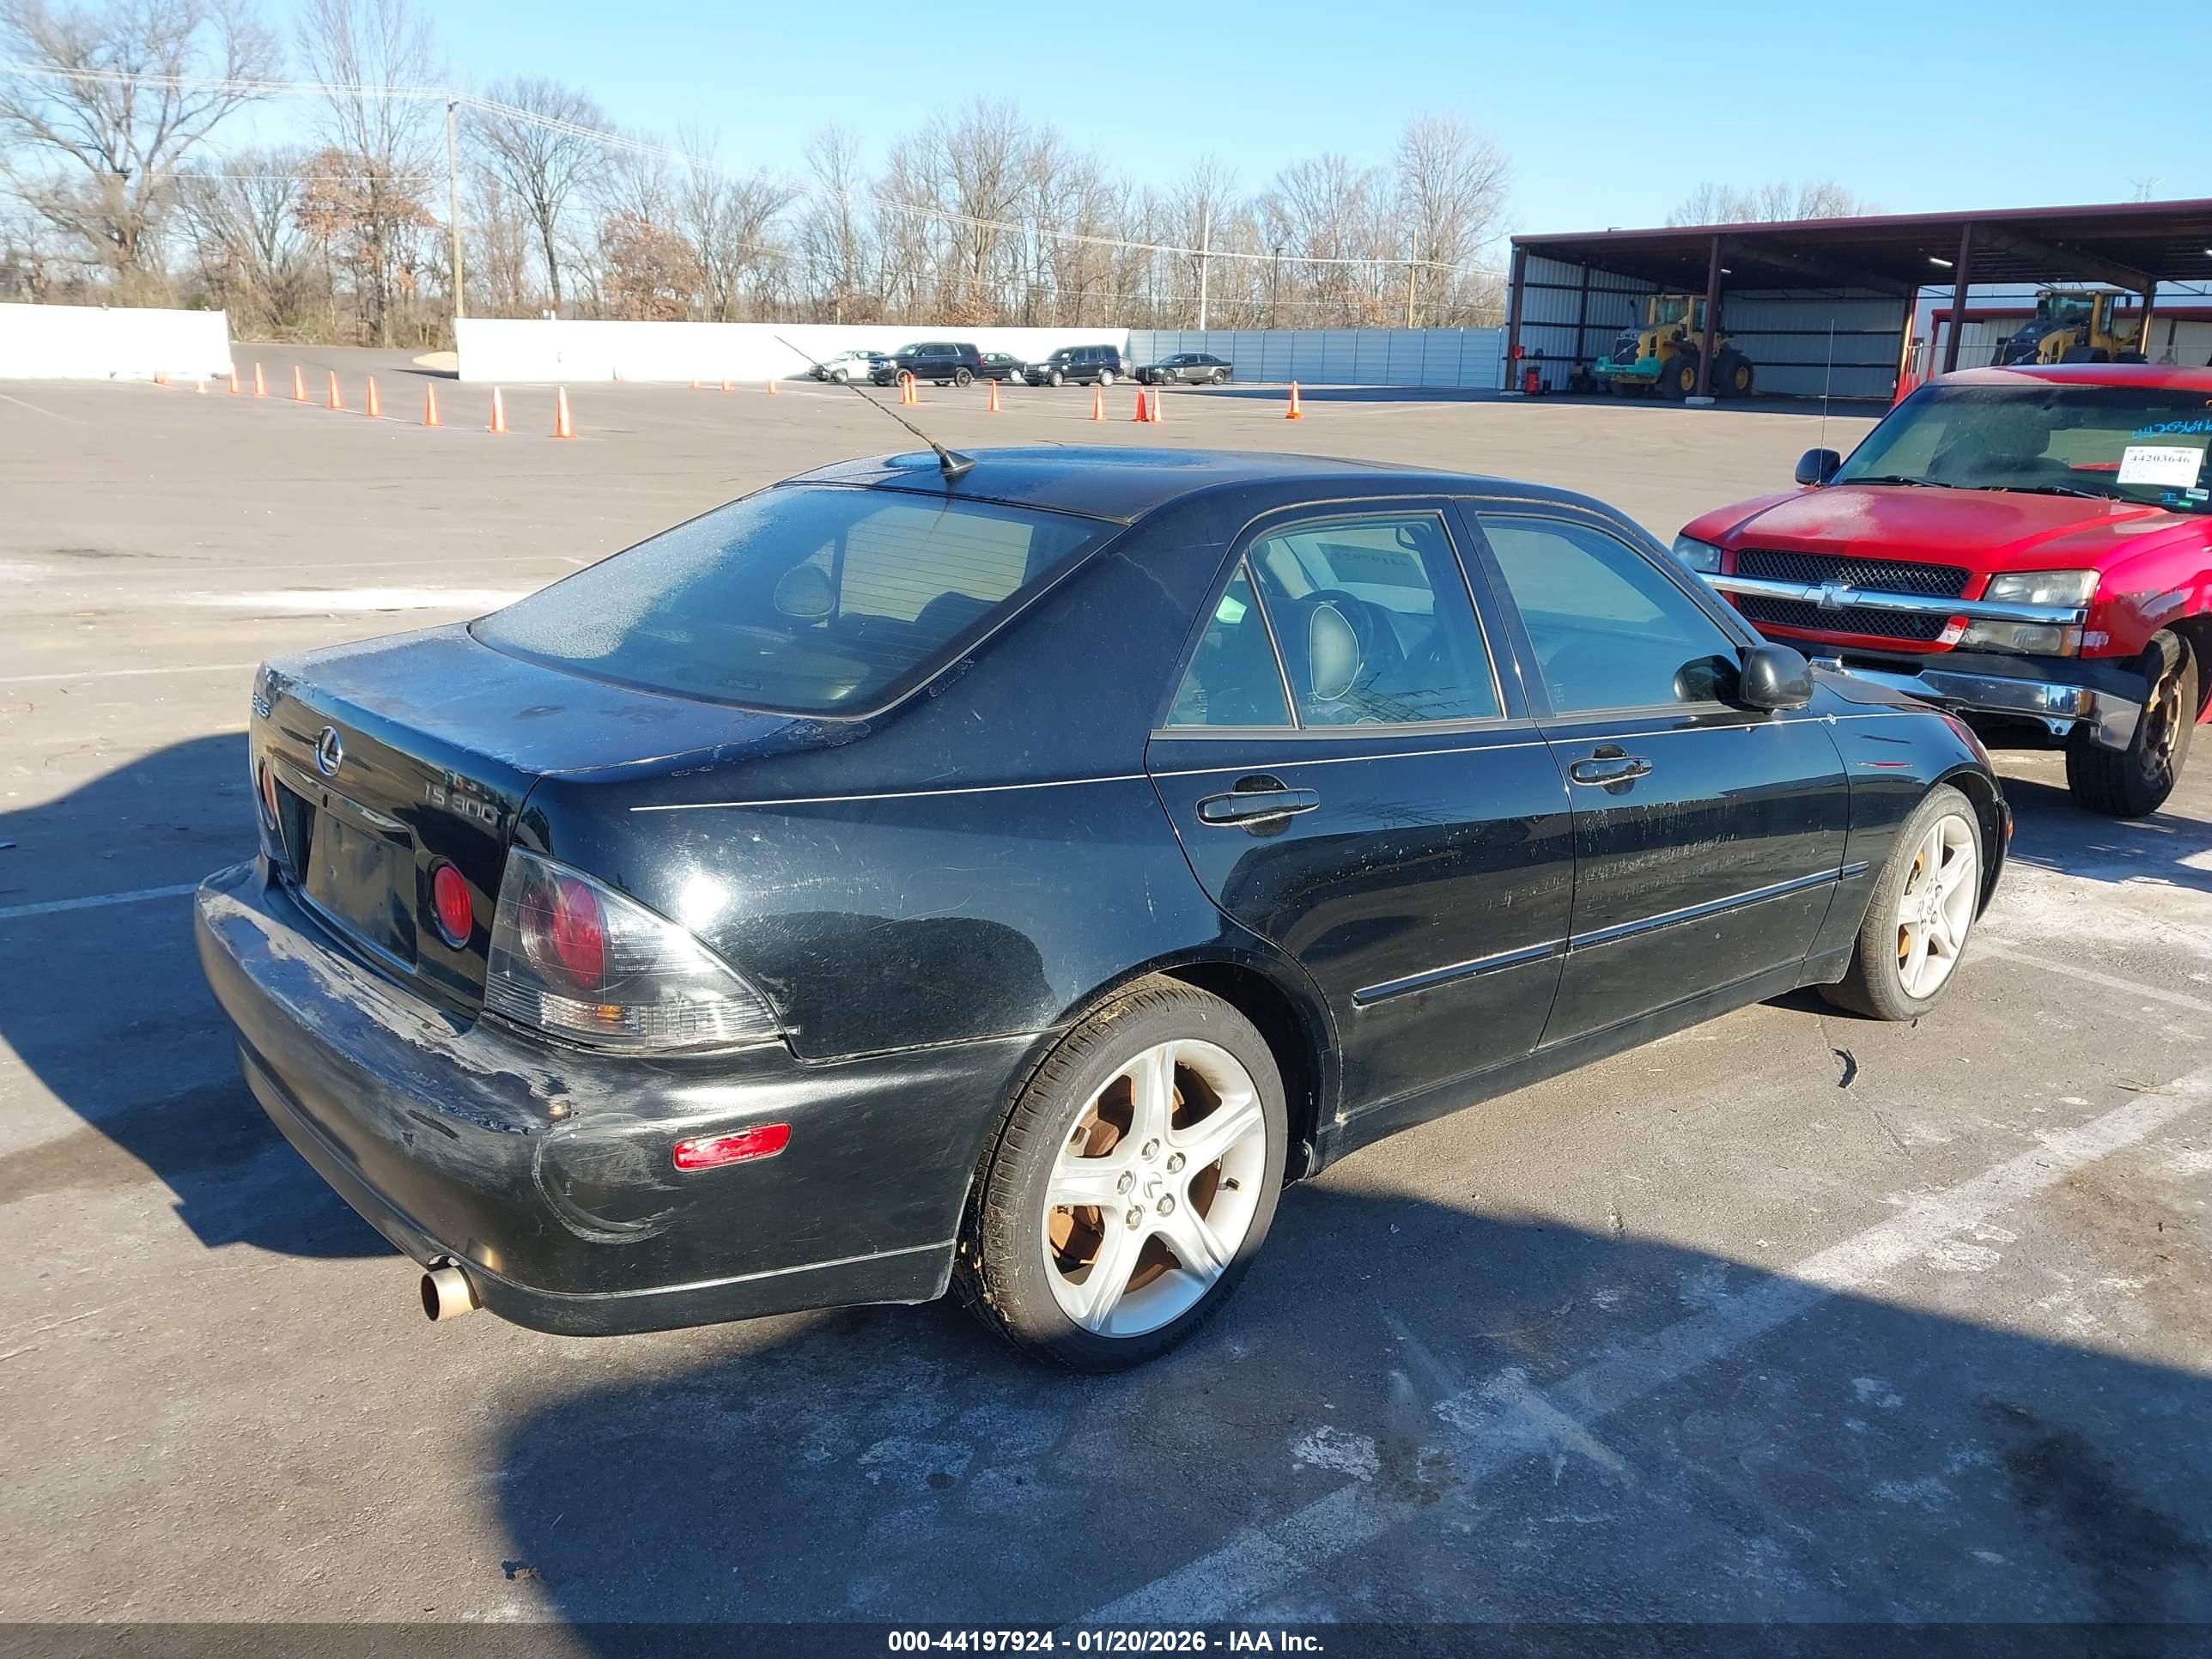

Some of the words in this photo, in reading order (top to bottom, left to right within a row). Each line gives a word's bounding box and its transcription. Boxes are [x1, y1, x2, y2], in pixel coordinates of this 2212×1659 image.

[2130, 454, 2191, 464] 44203646
[425, 782, 446, 805] IS
[452, 792, 498, 825] 300
